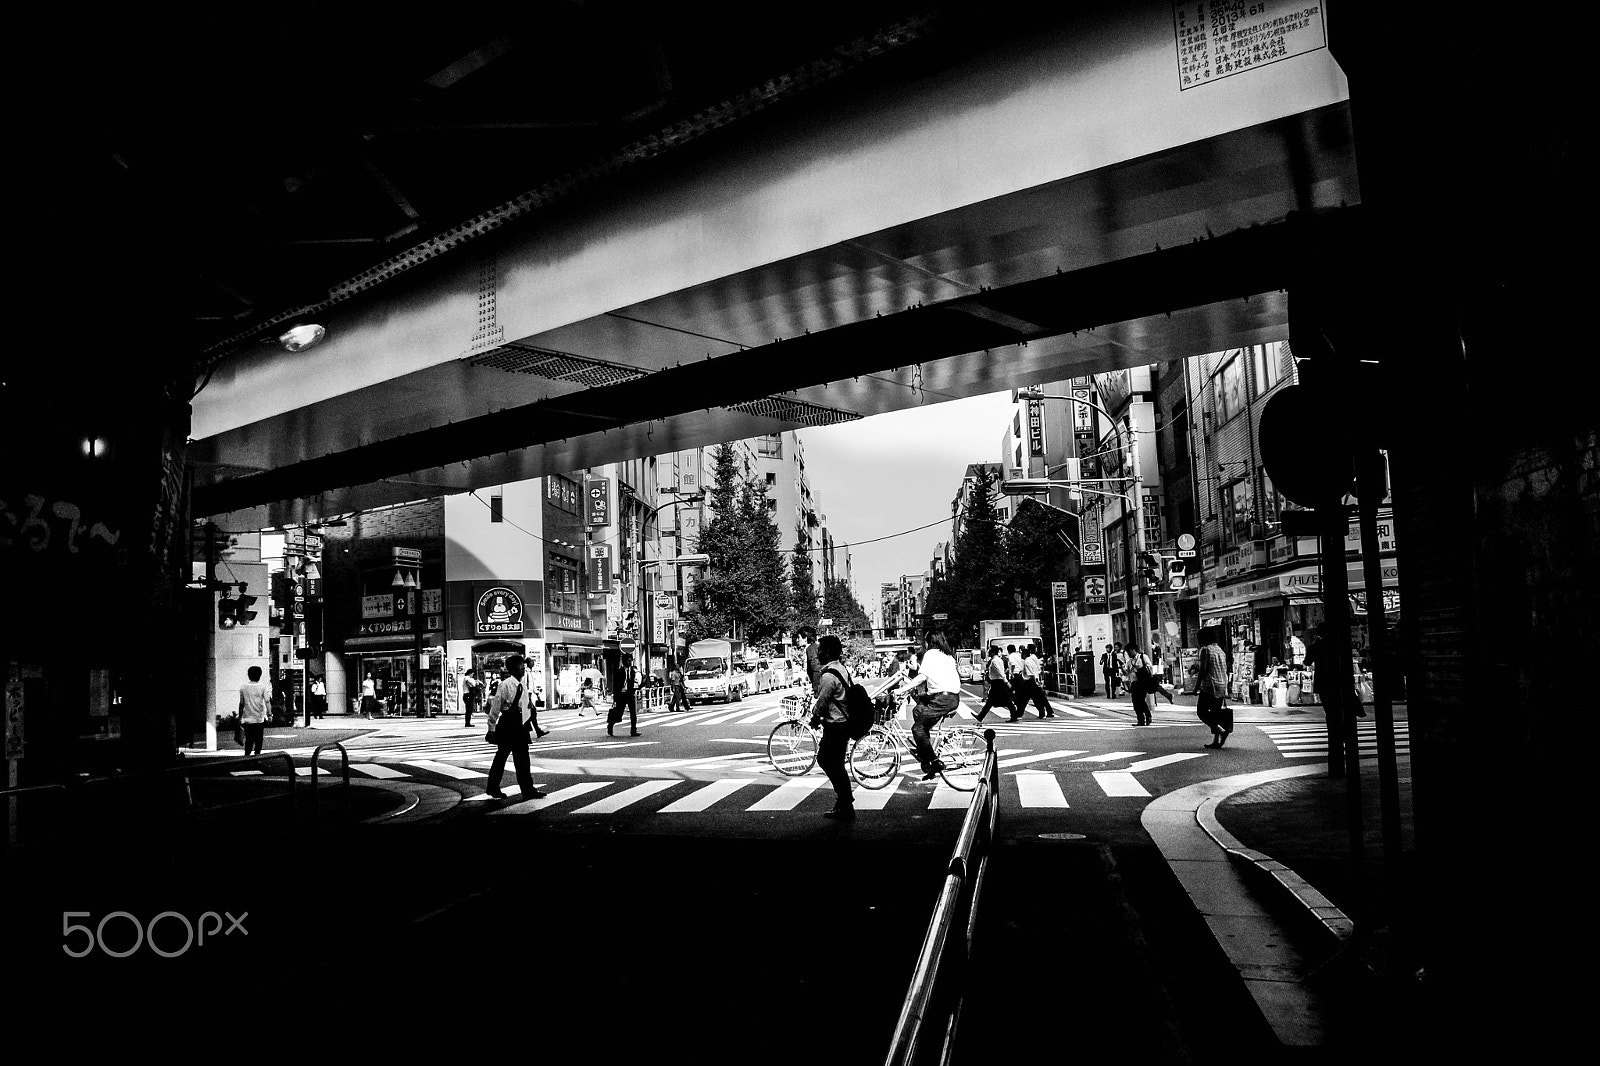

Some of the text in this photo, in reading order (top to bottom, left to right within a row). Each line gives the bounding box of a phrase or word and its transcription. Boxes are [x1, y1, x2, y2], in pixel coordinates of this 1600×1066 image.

[1214, 36, 1286, 64] 日本ペイント株式会社
[1216, 46, 1288, 75] 鹿島建設株式会社
[368, 619, 412, 633] くすりの福太郎
[480, 623, 520, 631] くすりの福太郎
